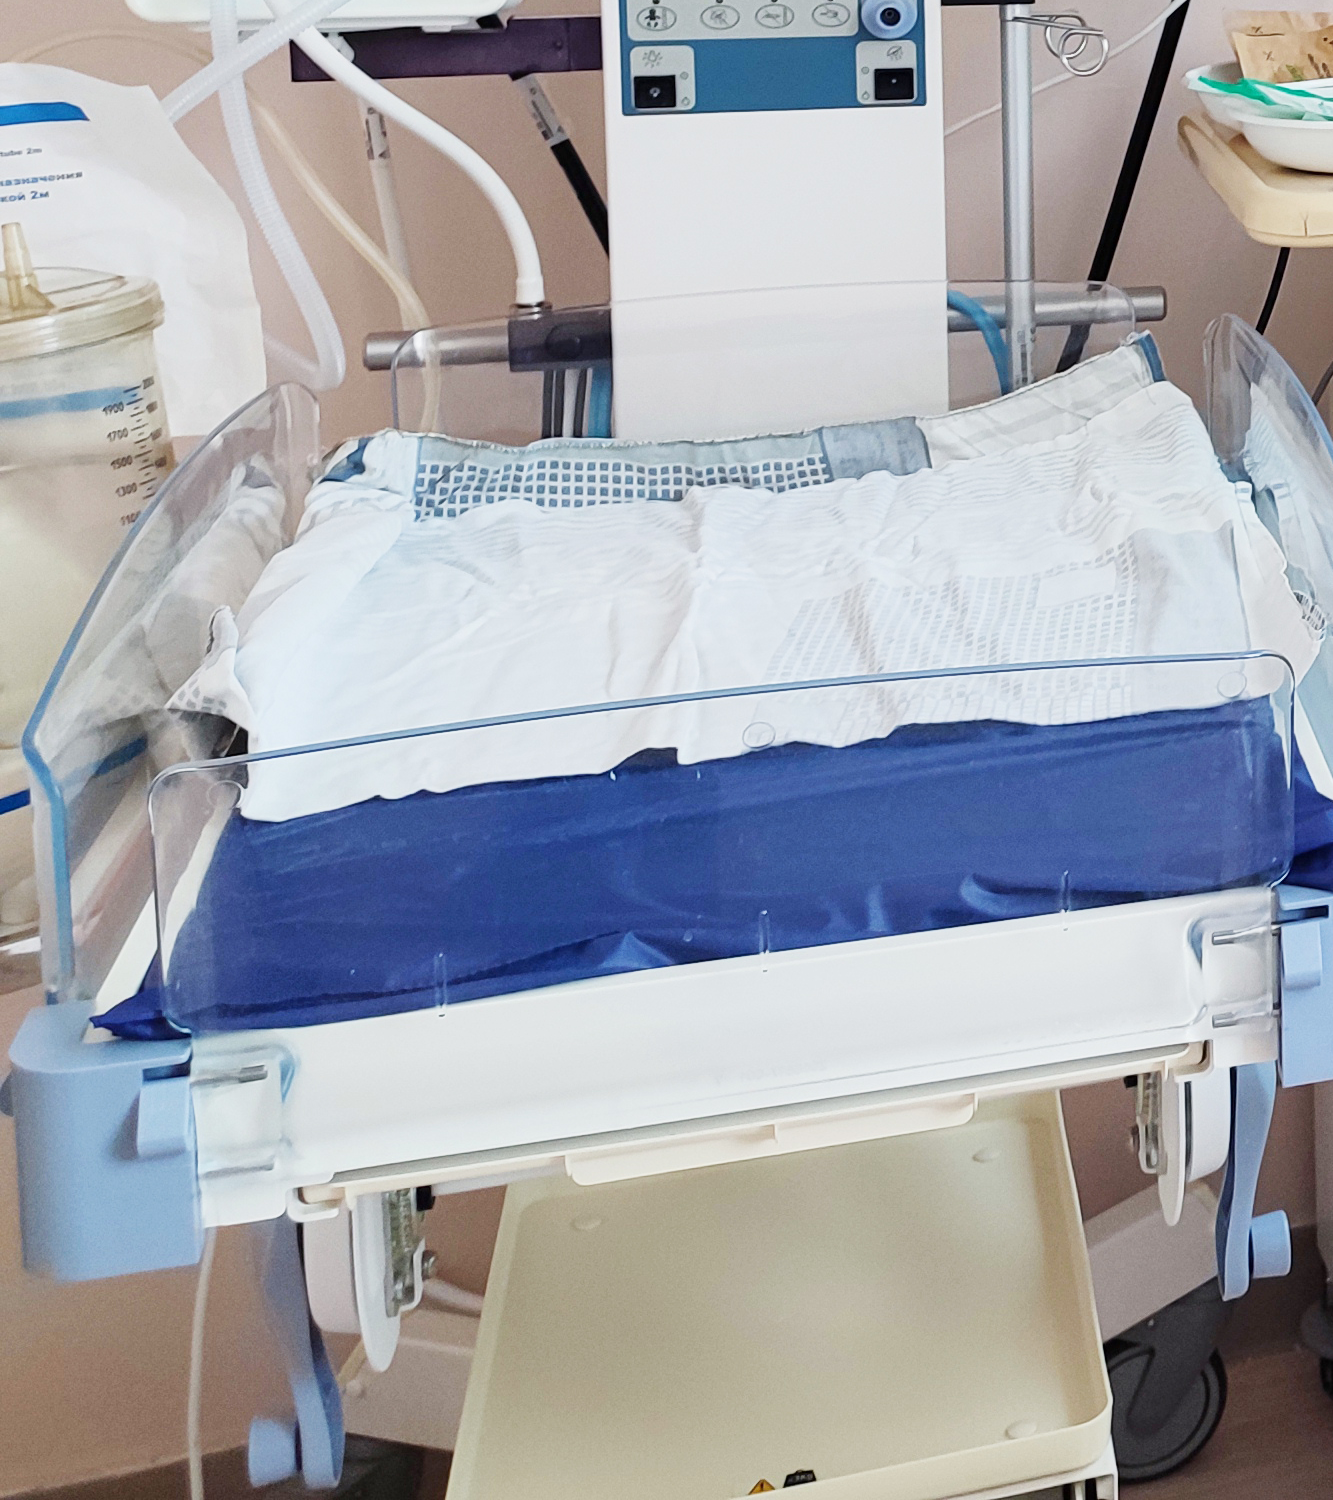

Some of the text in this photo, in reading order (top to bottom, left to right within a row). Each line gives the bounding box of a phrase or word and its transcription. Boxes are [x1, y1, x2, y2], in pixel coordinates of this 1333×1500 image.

[101, 401, 125, 416] 1900
[106, 427, 129, 442] 1700
[110, 455, 133, 470] 1500
[115, 482, 138, 497] 1300
